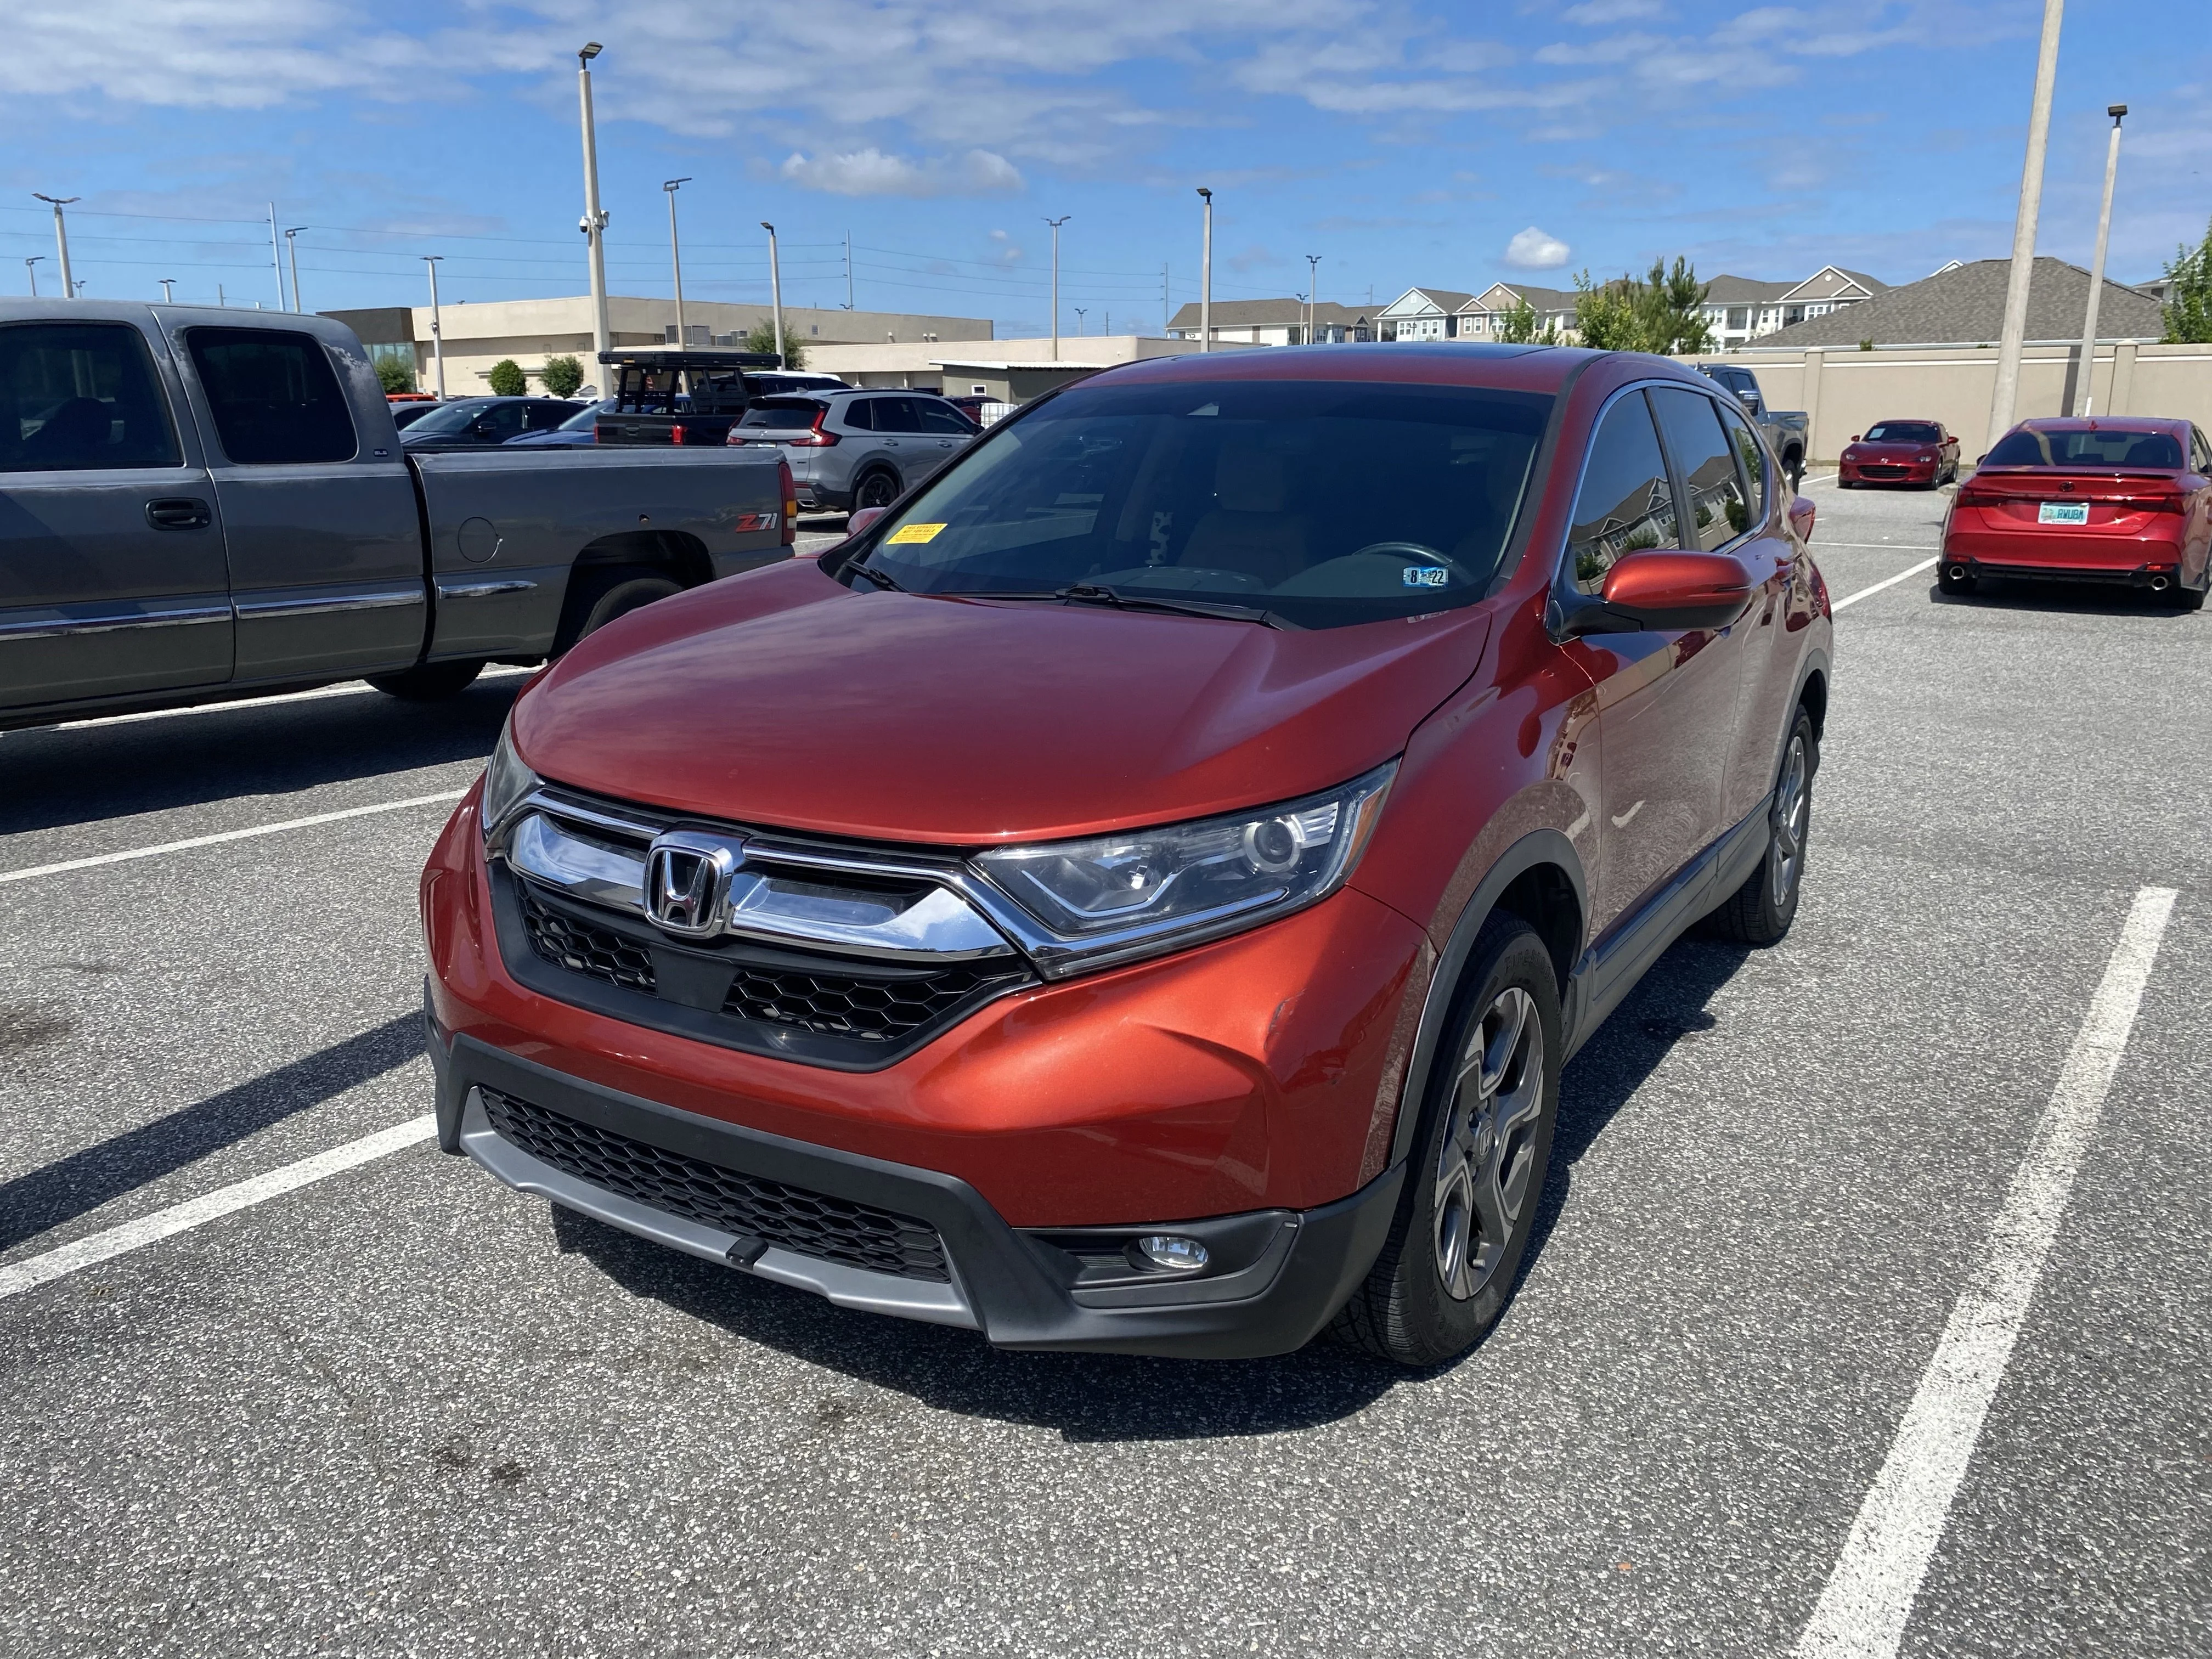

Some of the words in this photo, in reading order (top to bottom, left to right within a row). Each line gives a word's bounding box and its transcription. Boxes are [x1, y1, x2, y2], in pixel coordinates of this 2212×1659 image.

[735, 512, 778, 533] Z71
[1410, 569, 1418, 584] 8
[1431, 570, 1444, 584] 22
